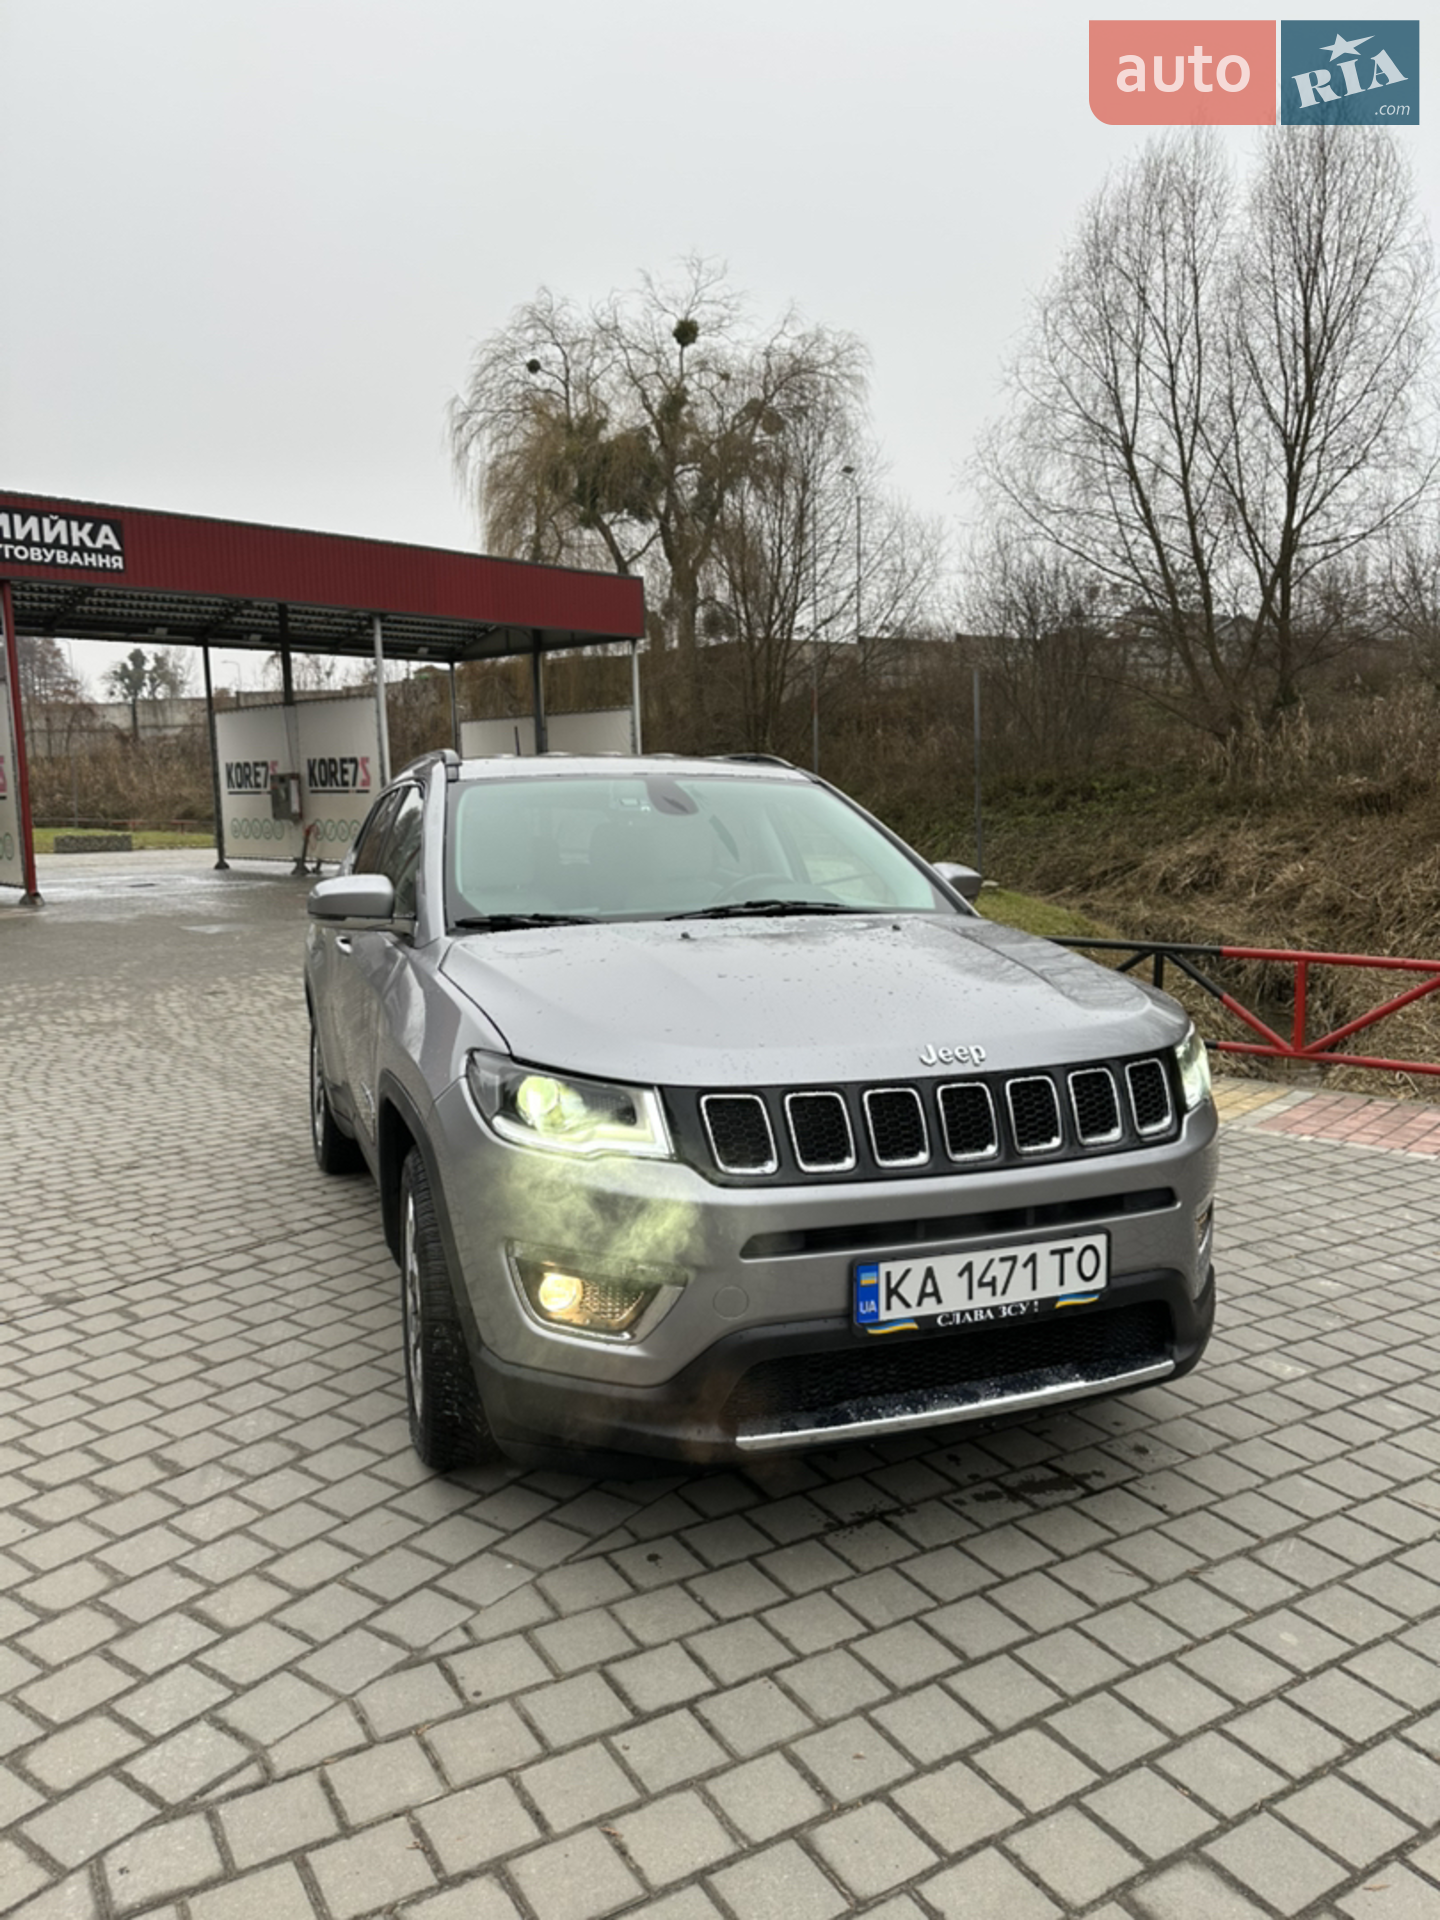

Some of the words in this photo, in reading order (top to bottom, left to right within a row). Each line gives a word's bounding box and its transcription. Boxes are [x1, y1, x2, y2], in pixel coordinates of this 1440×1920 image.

[0, 544, 124, 570] ГОВУВАННЯ
[919, 1044, 986, 1067] Jeep
[885, 1266, 943, 1311] KA
[957, 1252, 1037, 1301] 1471
[1050, 1244, 1101, 1287] TO
[859, 1300, 877, 1314] UA
[936, 1311, 994, 1327] СЛАВА
